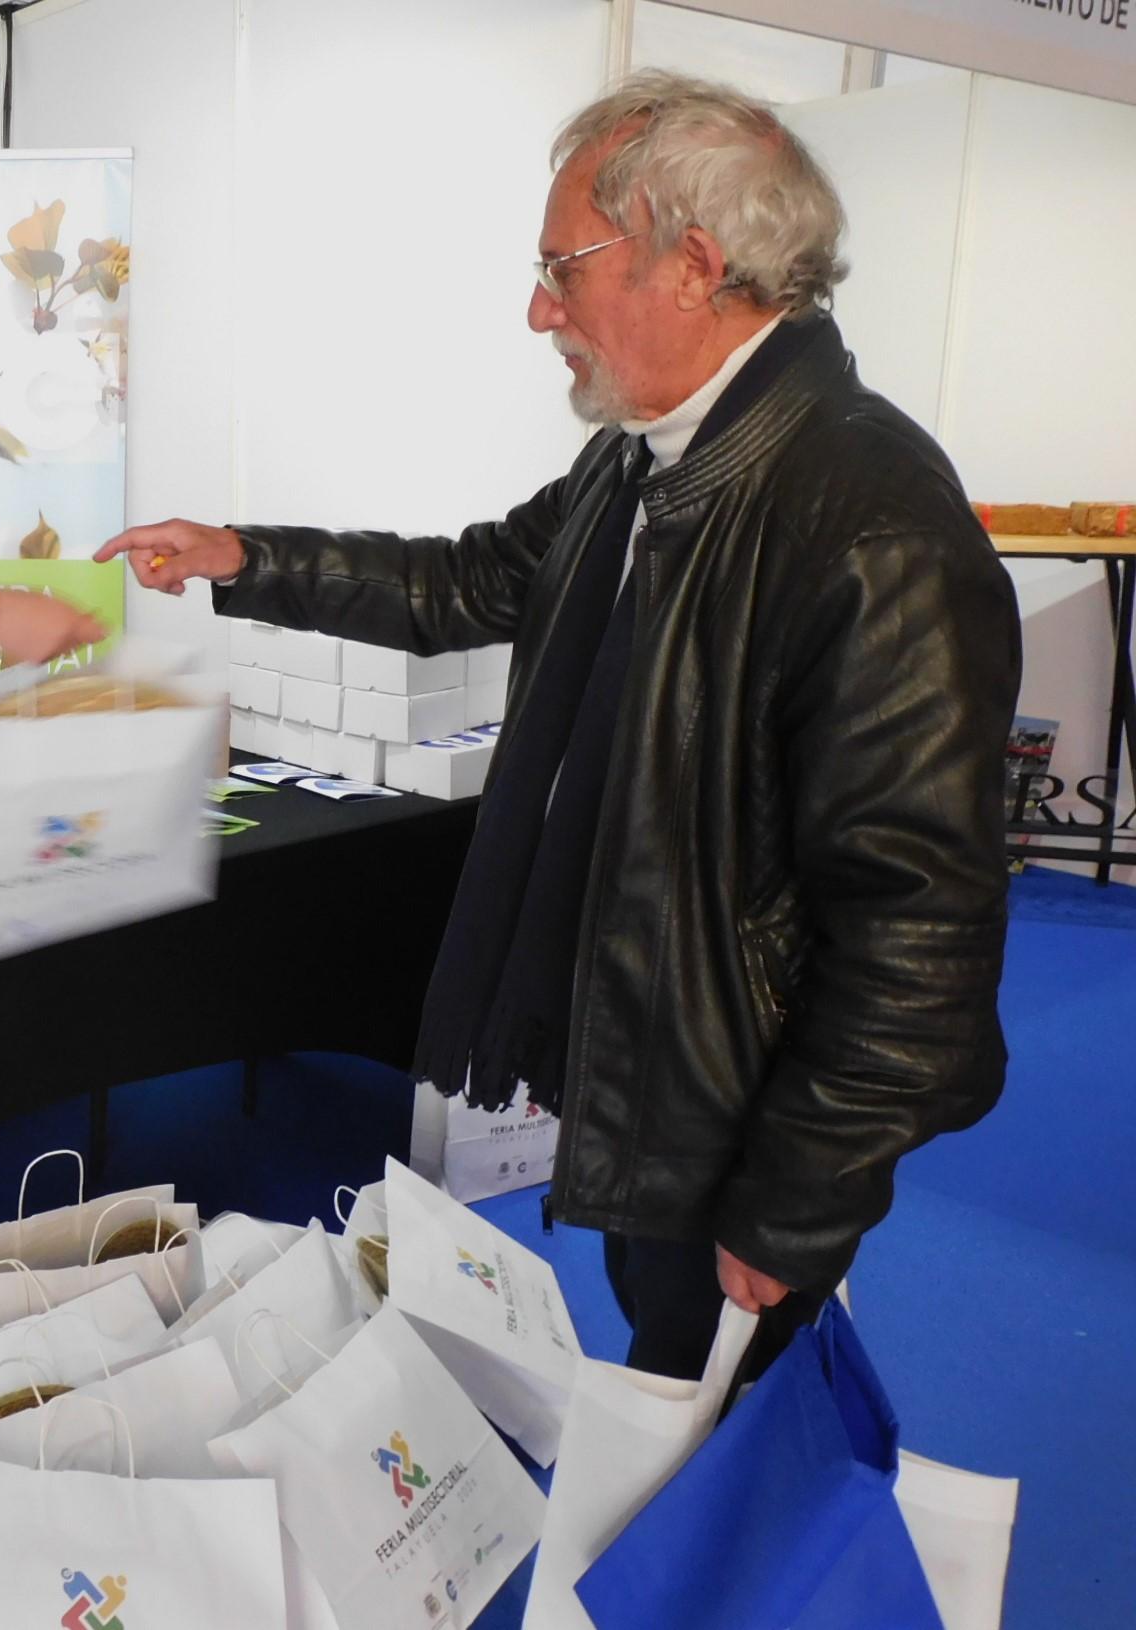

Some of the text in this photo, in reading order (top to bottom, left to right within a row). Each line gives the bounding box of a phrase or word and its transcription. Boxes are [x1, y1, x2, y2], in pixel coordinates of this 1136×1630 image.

[1100, 0, 1129, 30] DE
[375, 1460, 468, 1563] FERIA MULTISECTORIAL
